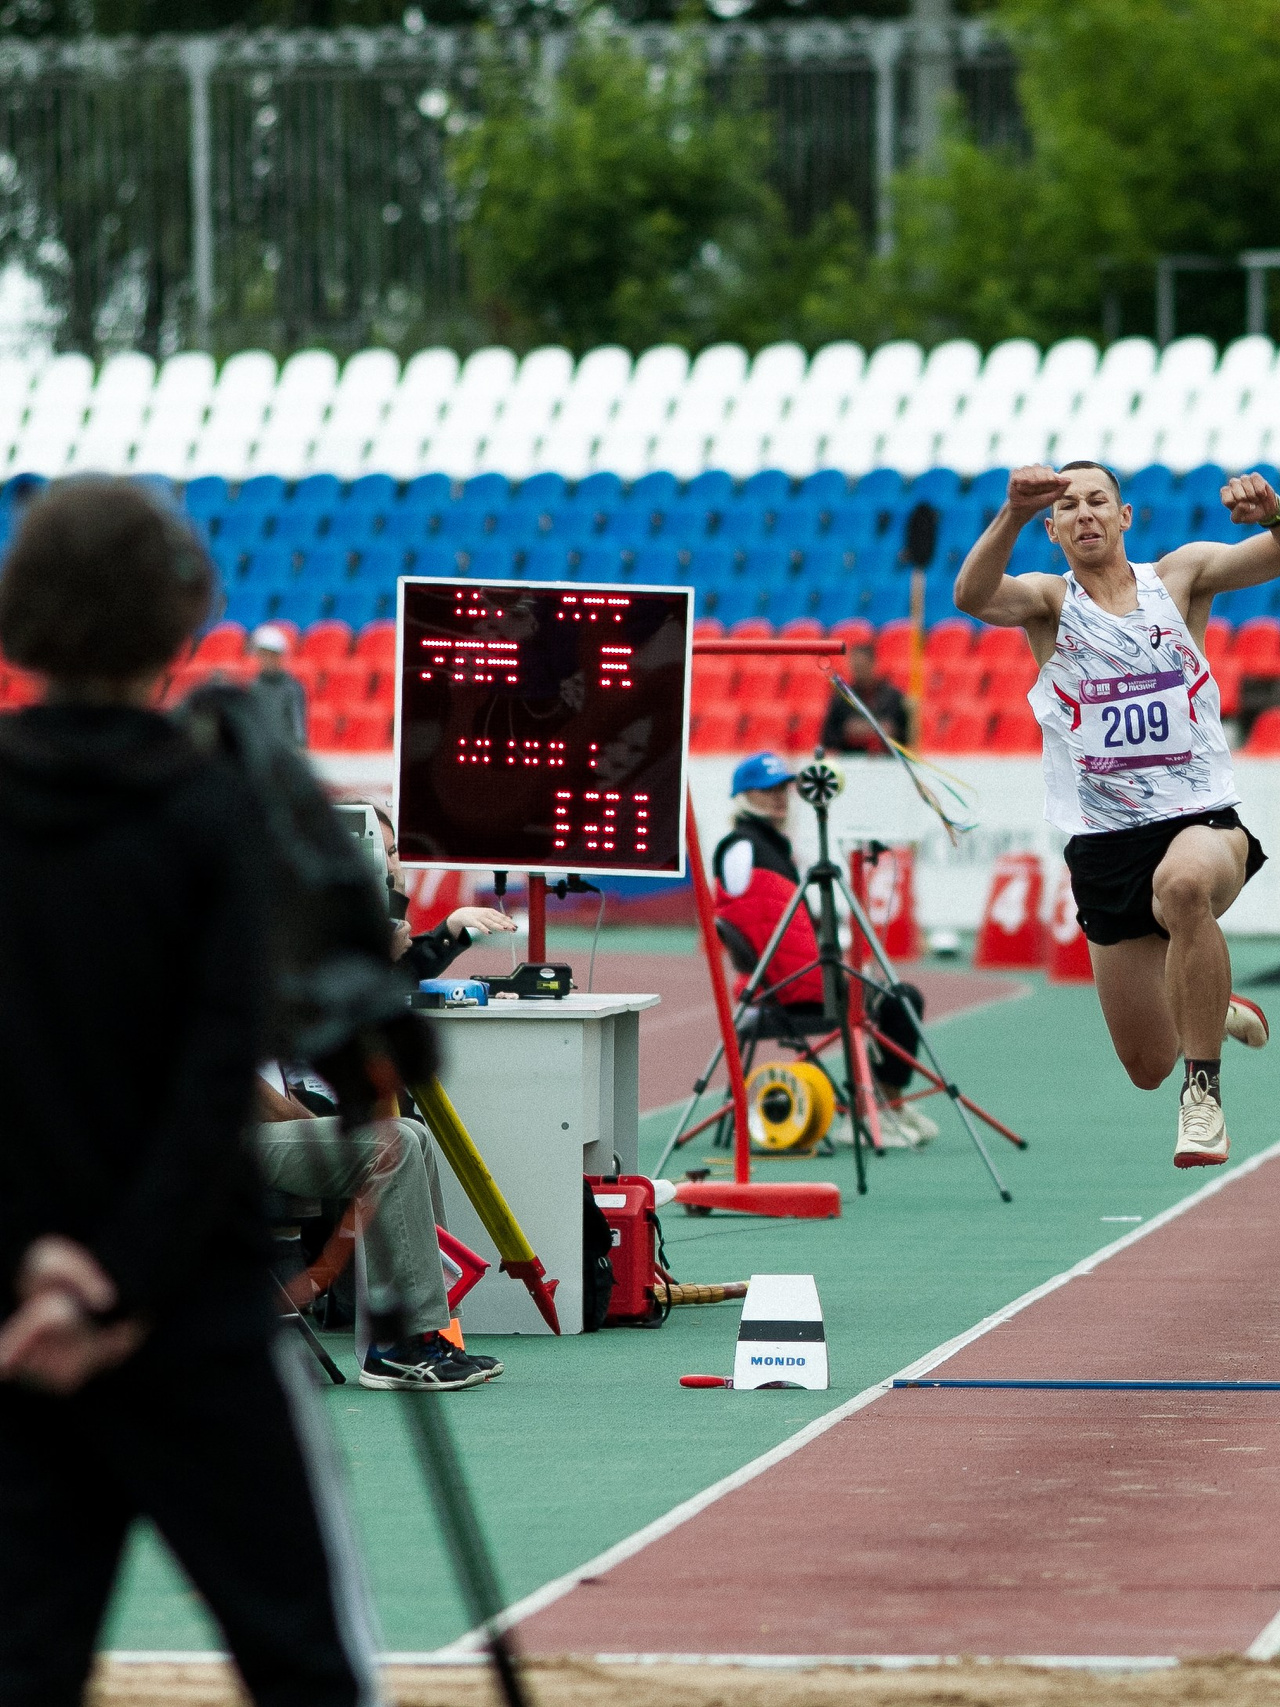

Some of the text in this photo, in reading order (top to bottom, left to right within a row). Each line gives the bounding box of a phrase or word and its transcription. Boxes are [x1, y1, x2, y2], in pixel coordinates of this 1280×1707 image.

[1101, 701, 1169, 748] 209
[990, 876, 1028, 935] 4
[750, 1356, 806, 1366] MONDO
